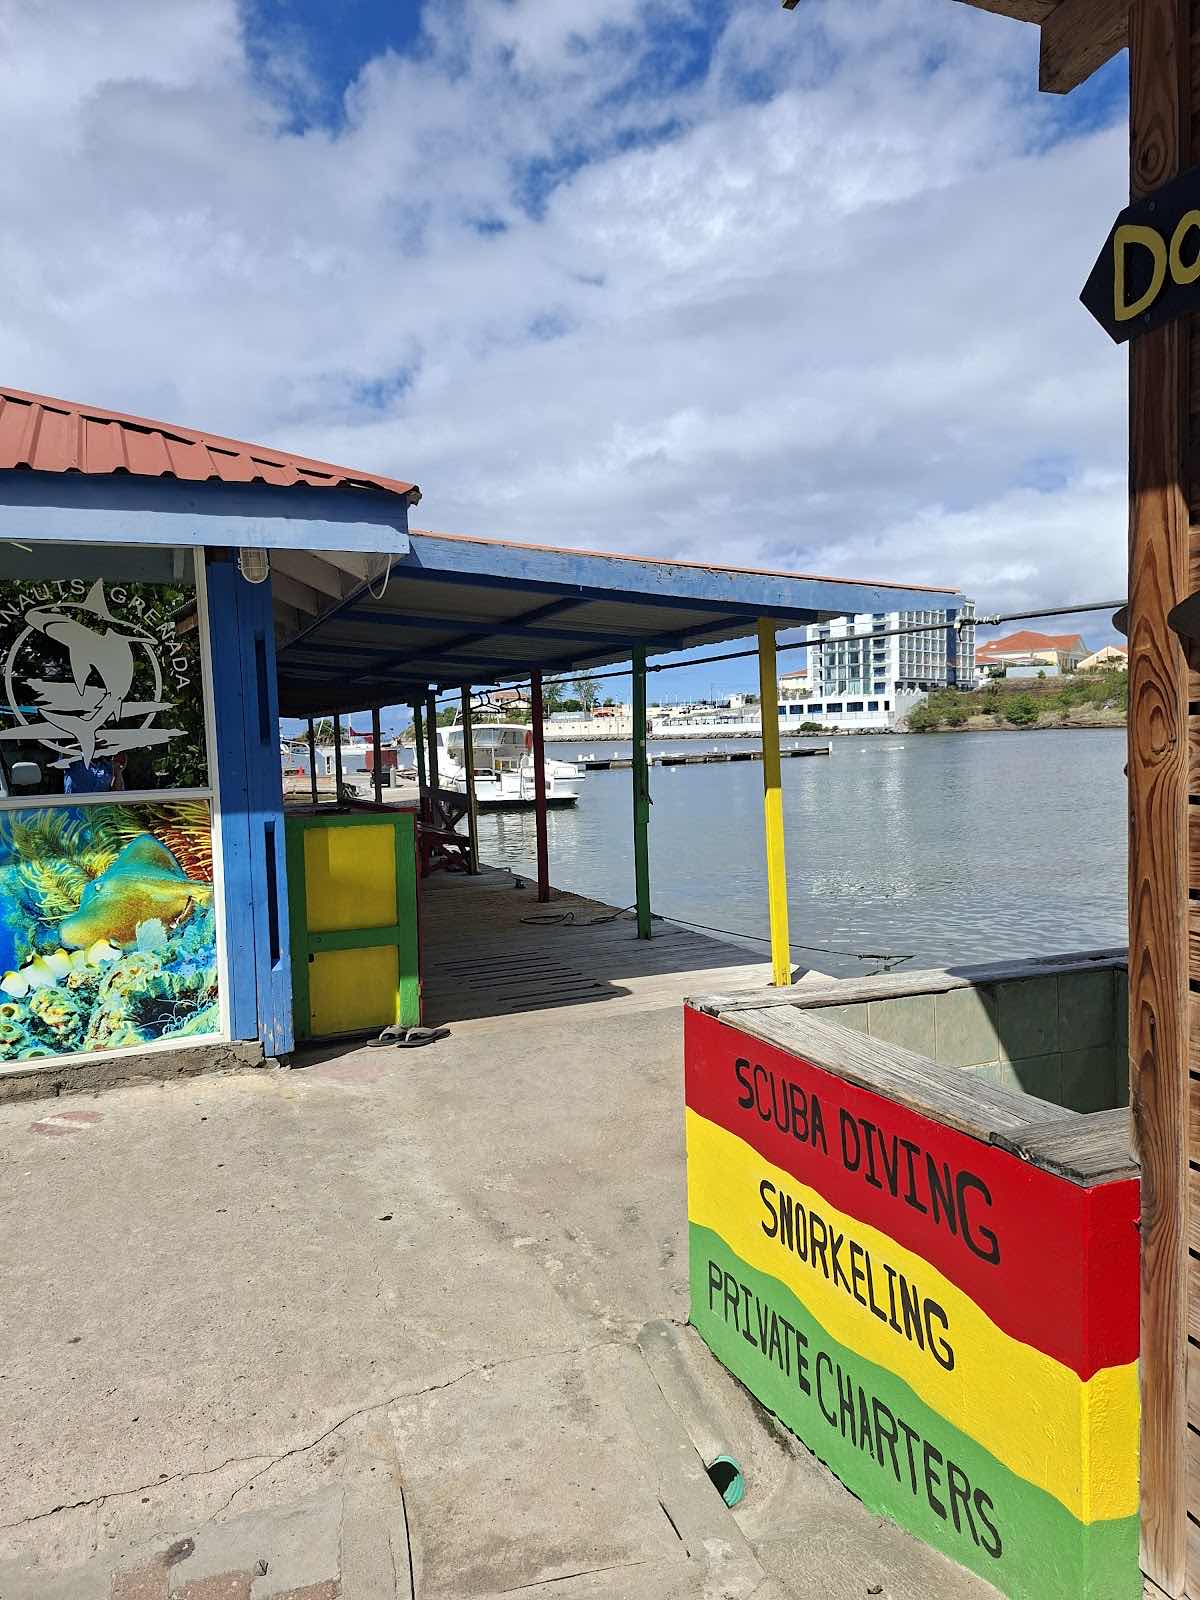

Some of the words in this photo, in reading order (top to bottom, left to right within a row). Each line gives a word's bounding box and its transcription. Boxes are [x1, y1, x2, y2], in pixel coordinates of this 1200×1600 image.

[110, 586, 191, 690] GRENADA
[734, 1058, 828, 1156] SCUBA
[839, 1106, 1001, 1265] DIVING
[759, 1179, 955, 1371] SNORKELING
[707, 1258, 811, 1396] PRIVATE
[816, 1351, 1003, 1559] CHARTERS
